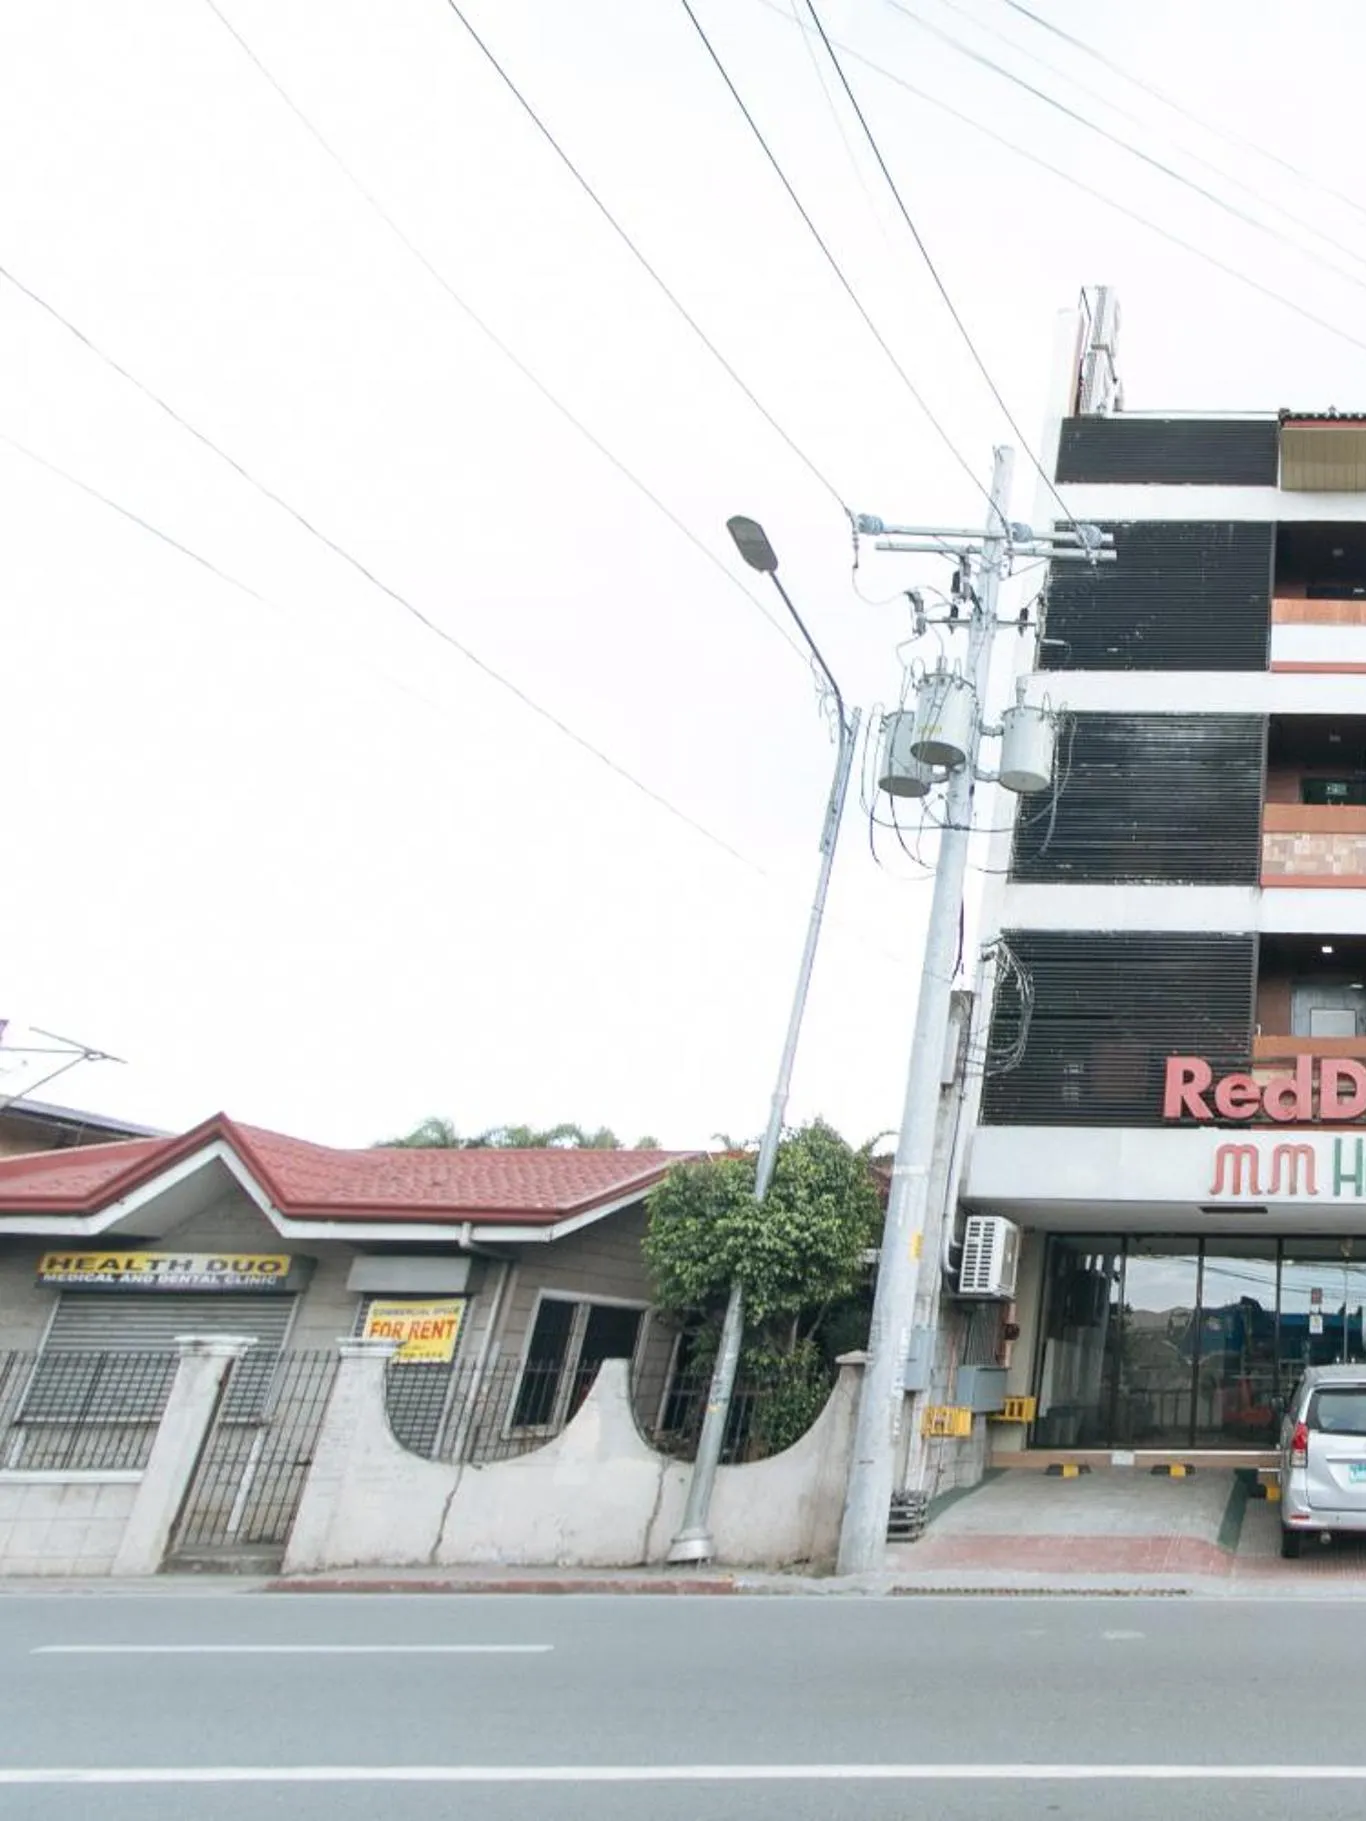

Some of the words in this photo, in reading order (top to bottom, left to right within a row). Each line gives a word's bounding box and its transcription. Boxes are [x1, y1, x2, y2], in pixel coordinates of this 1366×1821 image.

[45, 1256, 193, 1272] HEALTH
[206, 1258, 283, 1273] DUO
[43, 1273, 118, 1284] MEDICAL
[119, 1274, 152, 1284] AND
[155, 1274, 220, 1286] DENTAL
[223, 1275, 277, 1286] CLINIC
[370, 1320, 405, 1338] FOR
[407, 1318, 457, 1341] RENT
